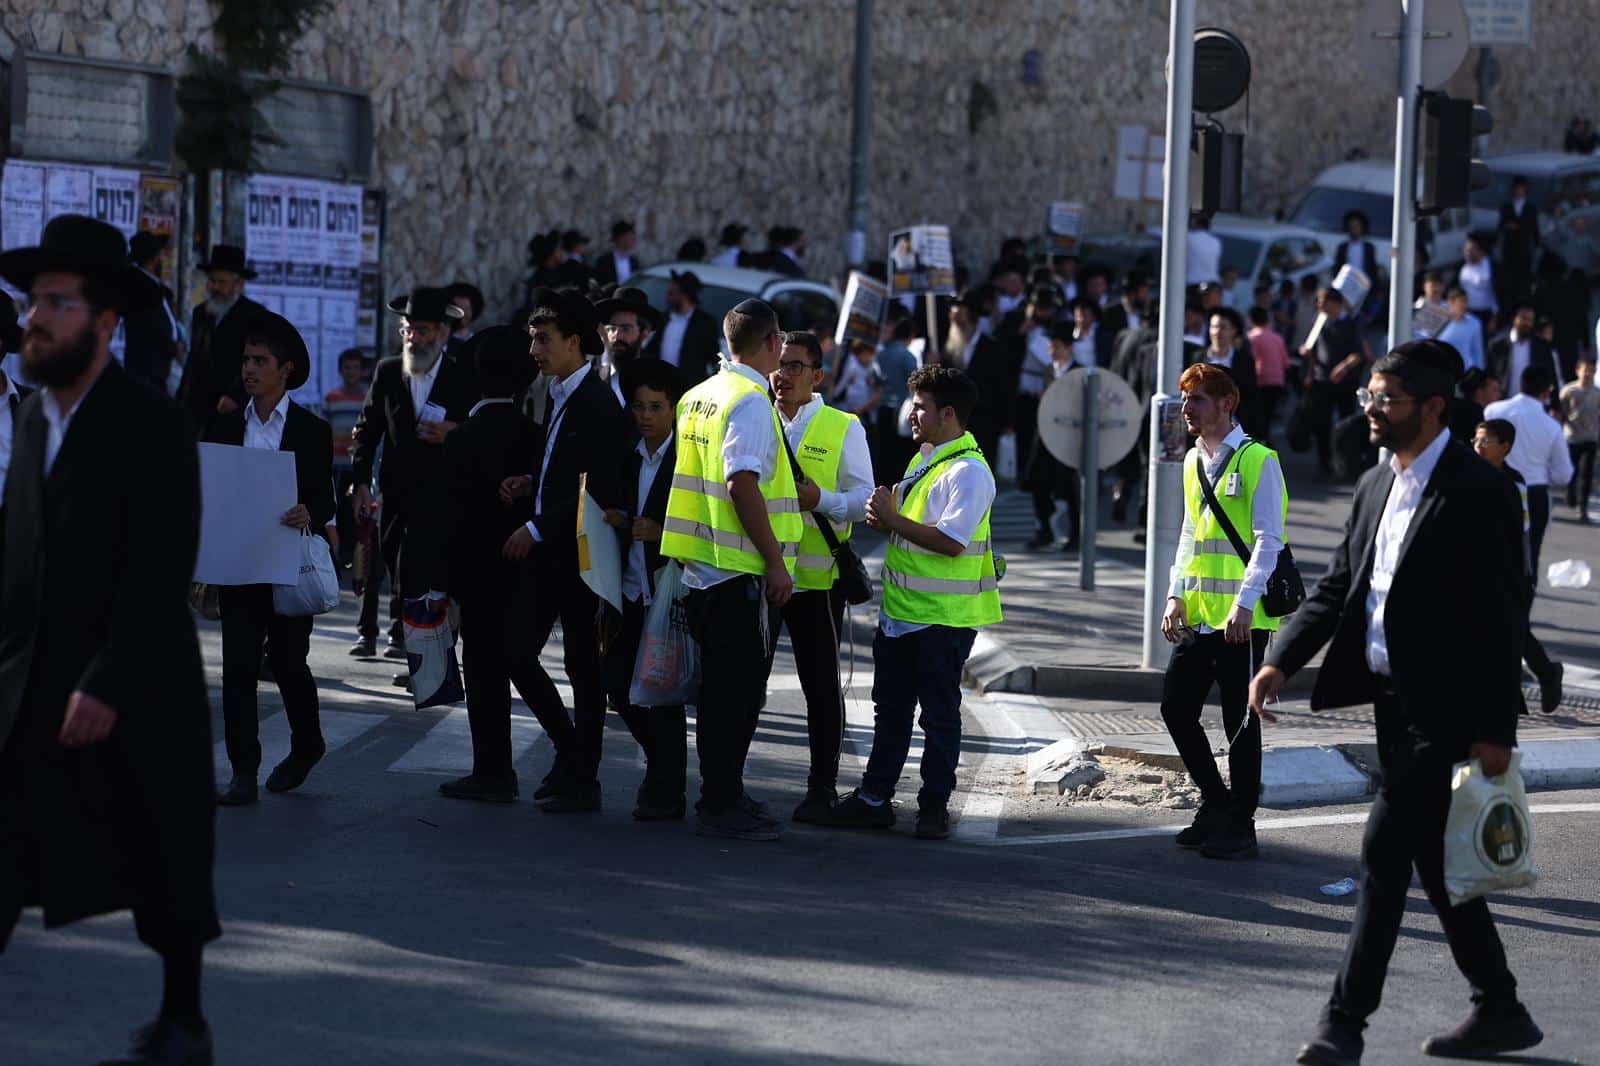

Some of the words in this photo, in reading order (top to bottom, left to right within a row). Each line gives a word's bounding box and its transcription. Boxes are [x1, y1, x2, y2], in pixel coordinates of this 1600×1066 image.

[96, 188, 135, 224] היום
[249, 193, 282, 227] היום
[288, 197, 321, 230] היום
[327, 201, 359, 234] היום
